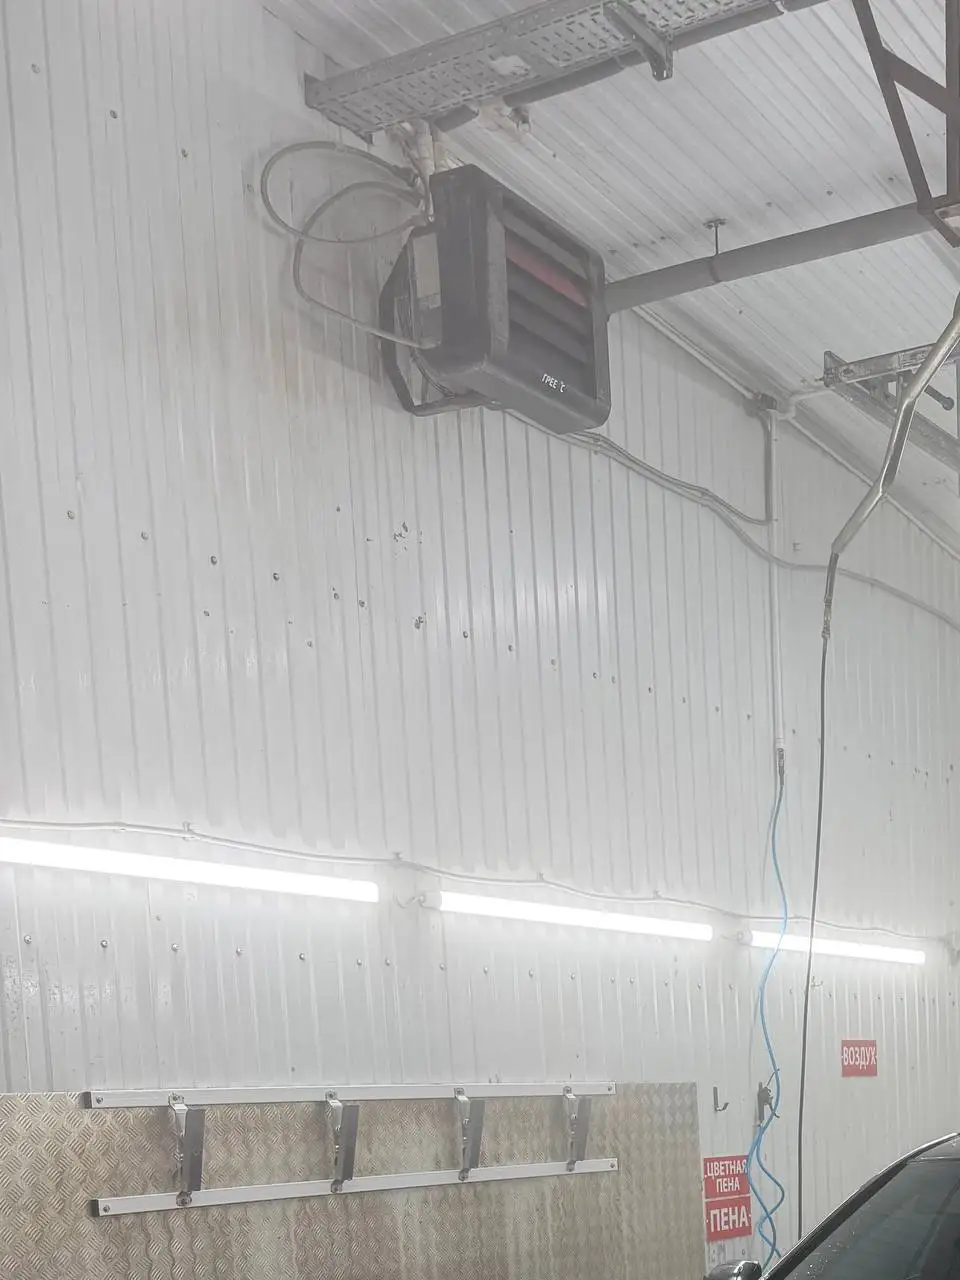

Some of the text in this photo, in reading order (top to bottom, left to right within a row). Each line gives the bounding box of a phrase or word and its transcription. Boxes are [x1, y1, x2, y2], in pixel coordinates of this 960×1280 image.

[843, 1046, 876, 1070] ВОЗДУХ
[716, 1177, 740, 1193] ПЕНА
[710, 1205, 749, 1232] ПЕНА
